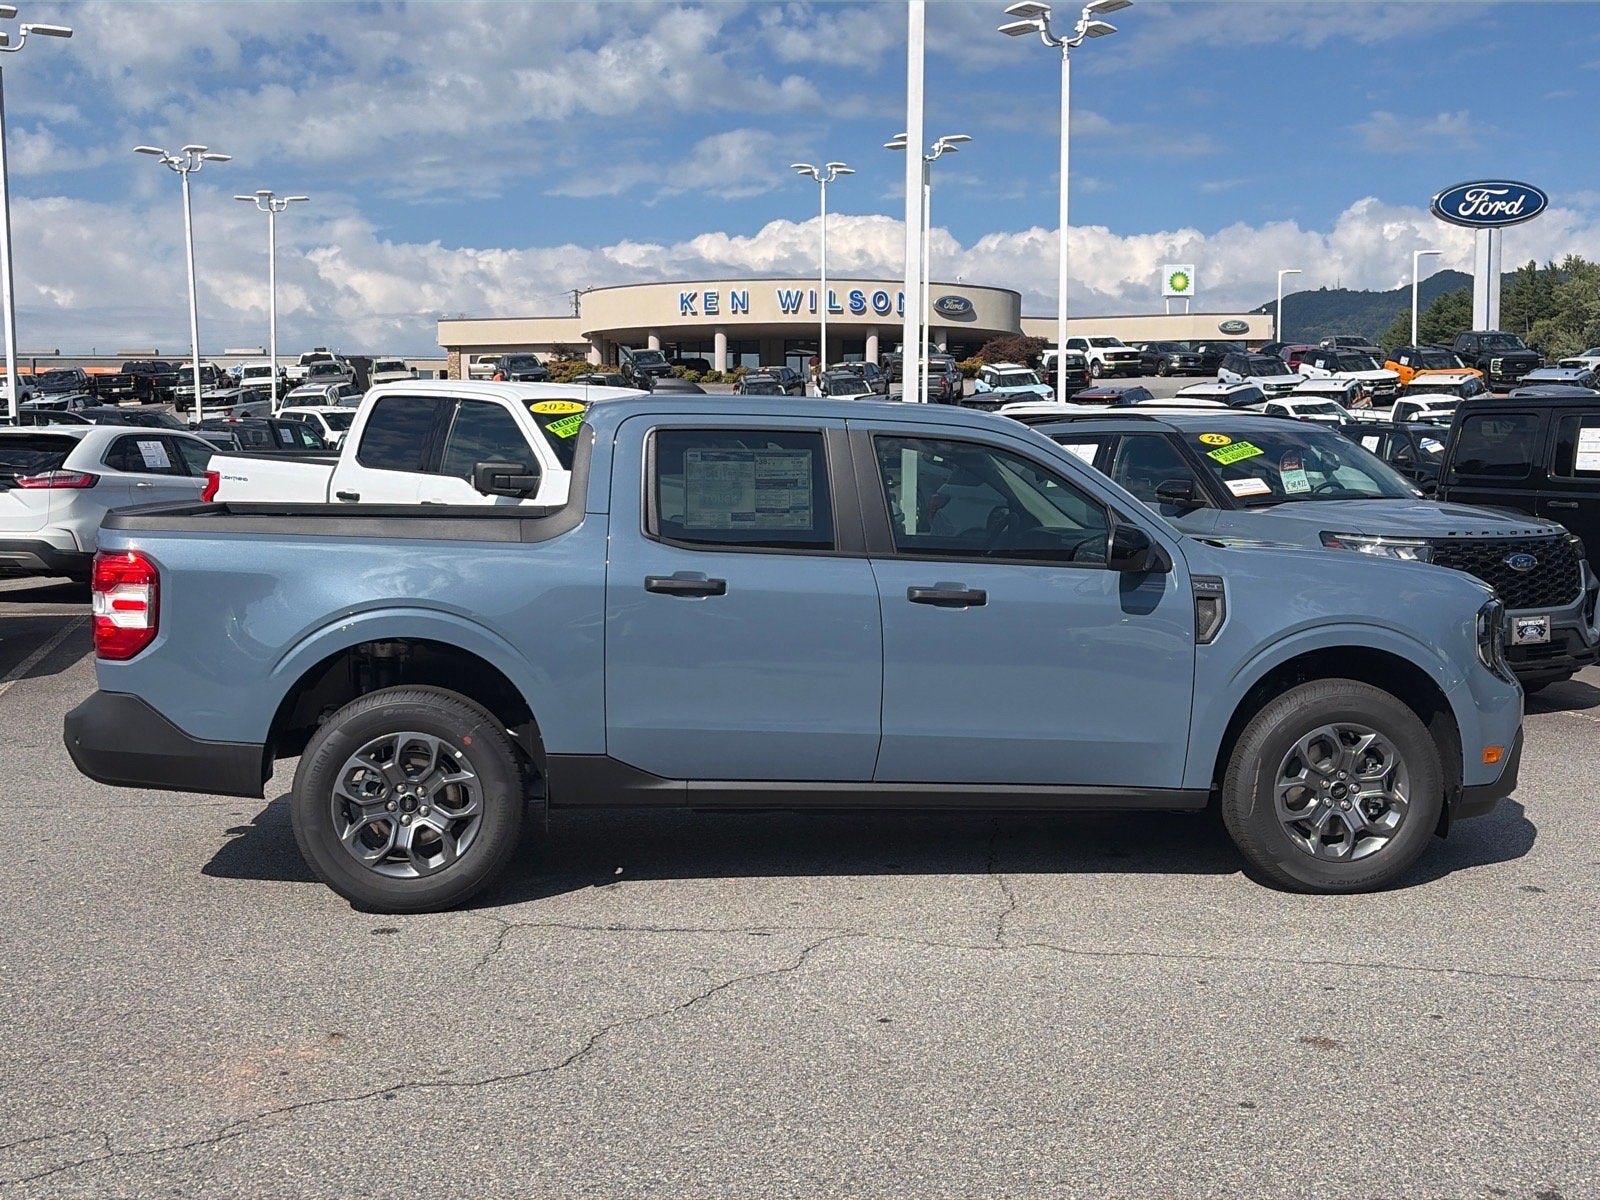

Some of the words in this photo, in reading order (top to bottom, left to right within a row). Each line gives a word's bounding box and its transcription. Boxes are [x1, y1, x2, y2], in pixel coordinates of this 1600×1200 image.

[1458, 188, 1526, 216] Ford
[680, 290, 748, 312] KEN
[943, 299, 964, 310] Ford
[541, 403, 574, 411] 2023
[1211, 442, 1249, 457] REDUCED
[1448, 528, 1554, 536] EXPLORER
